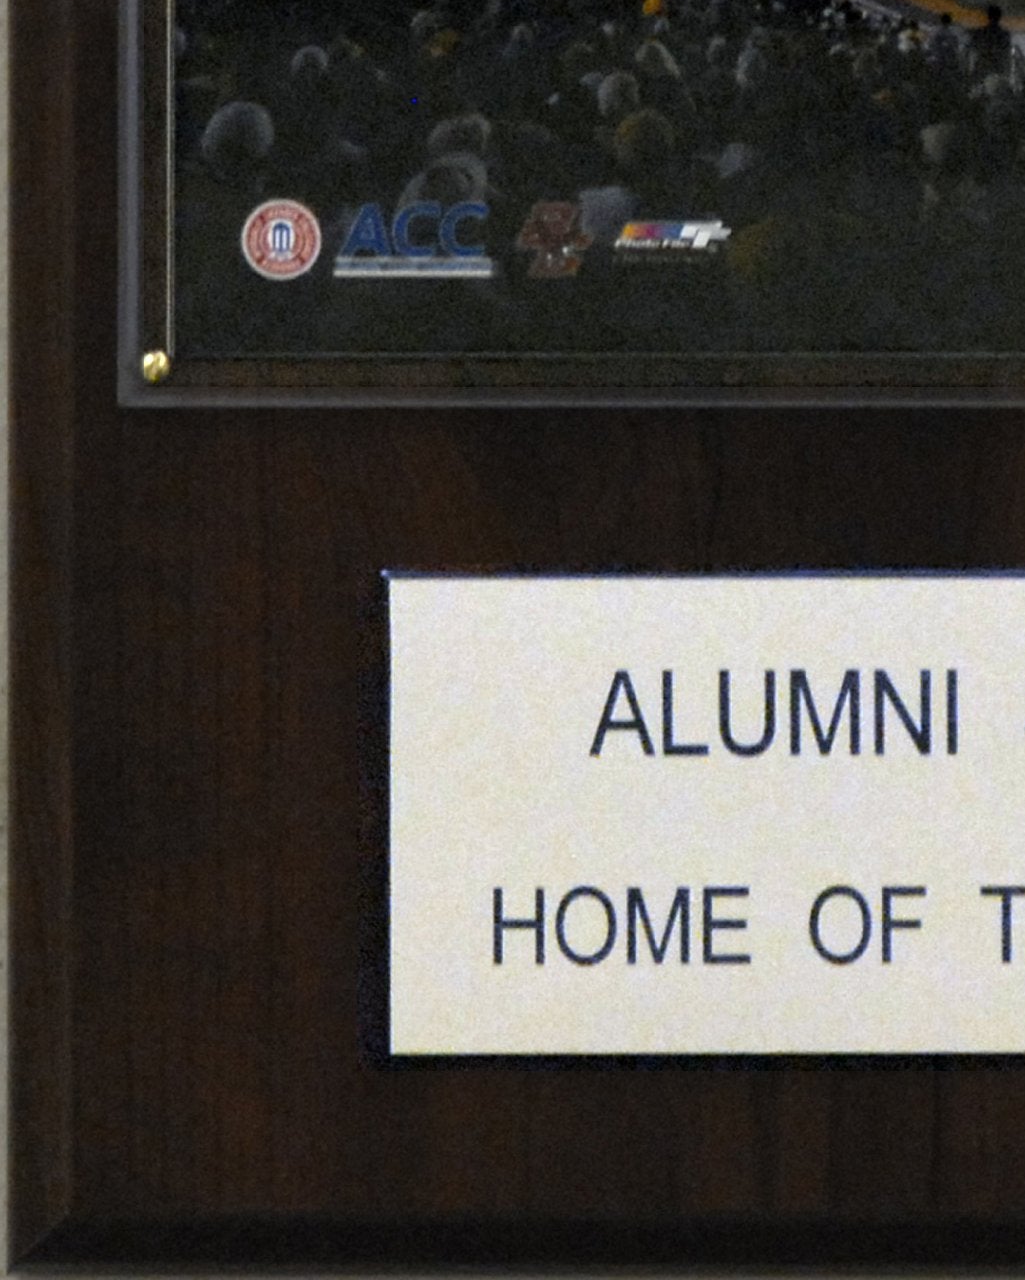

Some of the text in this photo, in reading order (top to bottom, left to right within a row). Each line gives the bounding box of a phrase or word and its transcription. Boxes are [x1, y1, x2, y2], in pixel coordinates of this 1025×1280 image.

[338, 200, 491, 257] ACC
[589, 669, 958, 757] ALUMNI
[493, 886, 751, 966] HOME
[808, 885, 926, 966] OF
